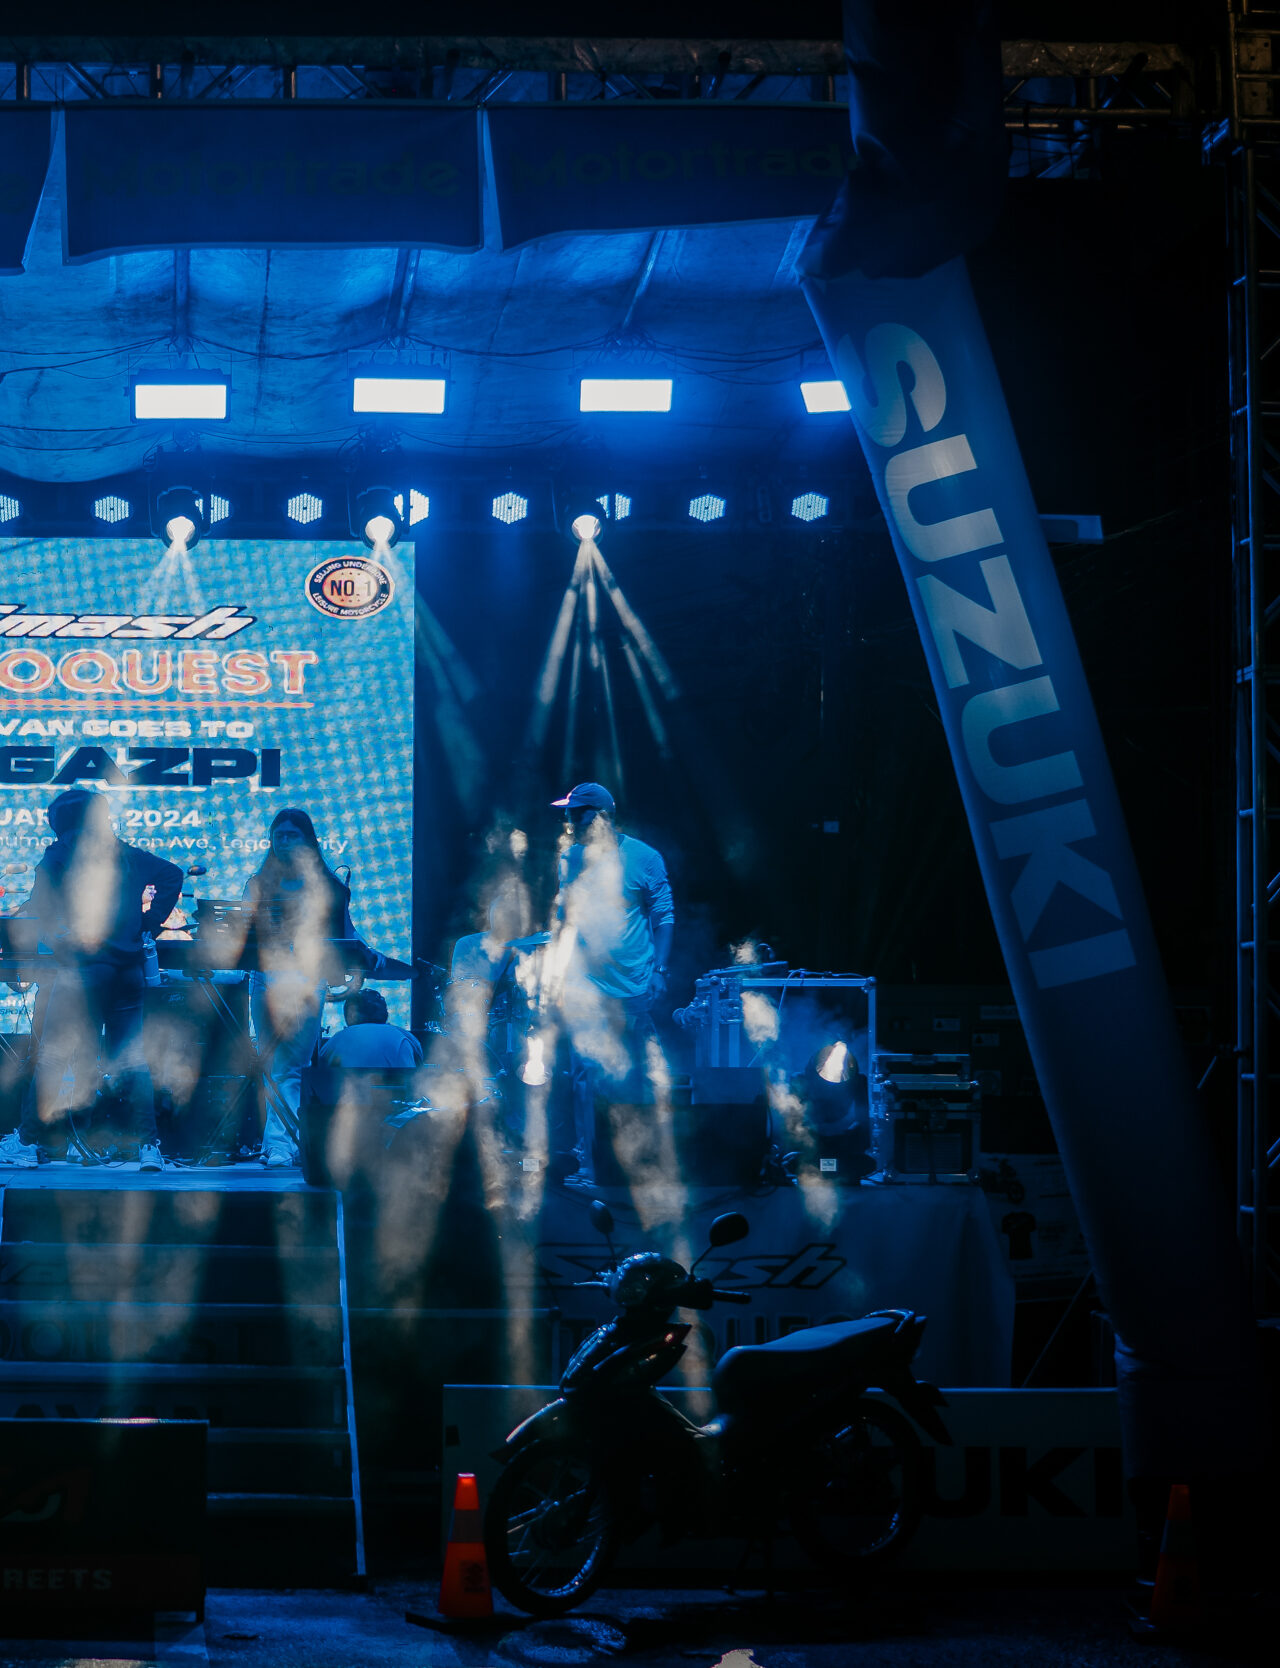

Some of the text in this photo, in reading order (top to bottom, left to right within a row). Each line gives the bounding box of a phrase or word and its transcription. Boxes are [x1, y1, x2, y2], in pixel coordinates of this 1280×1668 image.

[81, 151, 461, 200] Motortrade
[330, 580, 371, 597] NO. 1
[843, 323, 1138, 990] SUZUKI
[81, 719, 190, 738] GOES
[200, 720, 254, 739] TO
[125, 809, 202, 828] 2024
[221, 835, 271, 852] Lega
[318, 835, 349, 854] ity
[916, 1447, 1122, 1517] UKI
